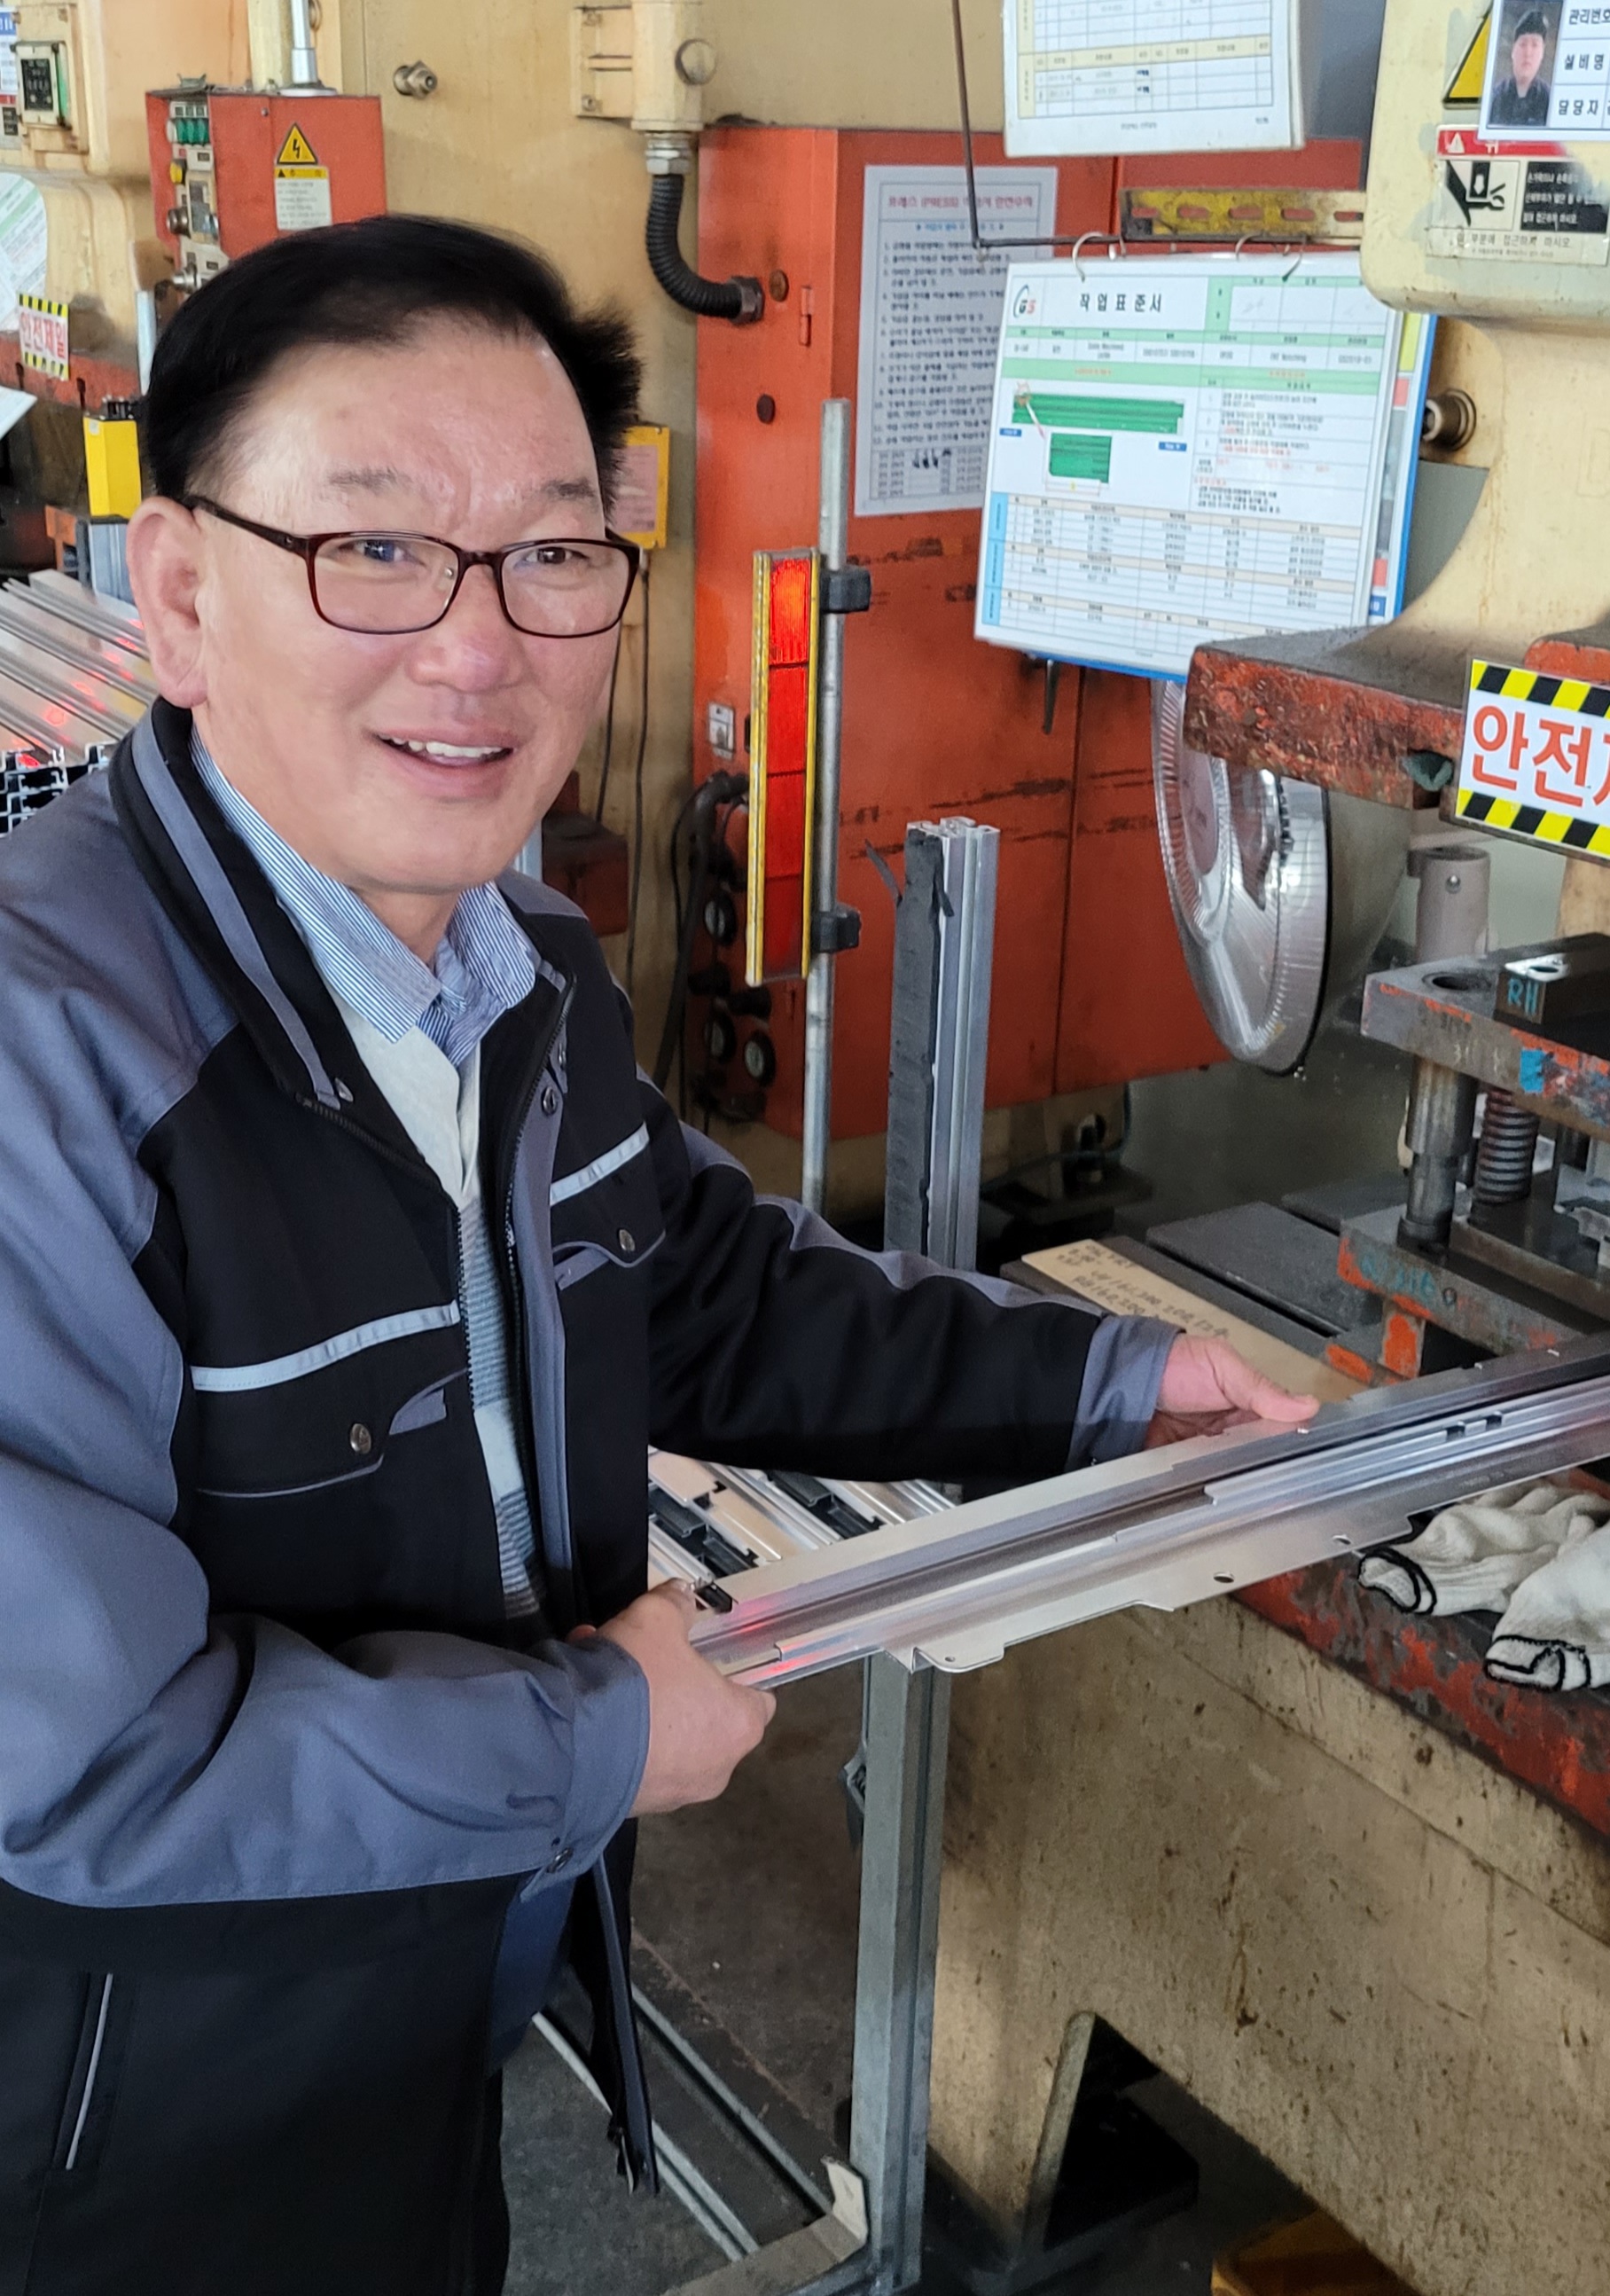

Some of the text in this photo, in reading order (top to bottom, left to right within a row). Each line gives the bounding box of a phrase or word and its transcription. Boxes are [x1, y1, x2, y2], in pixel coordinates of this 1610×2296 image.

[1568, 8, 1610, 25] 관리번호
[1473, 705, 1610, 808] 안전
[1508, 977, 1539, 1016] RH
